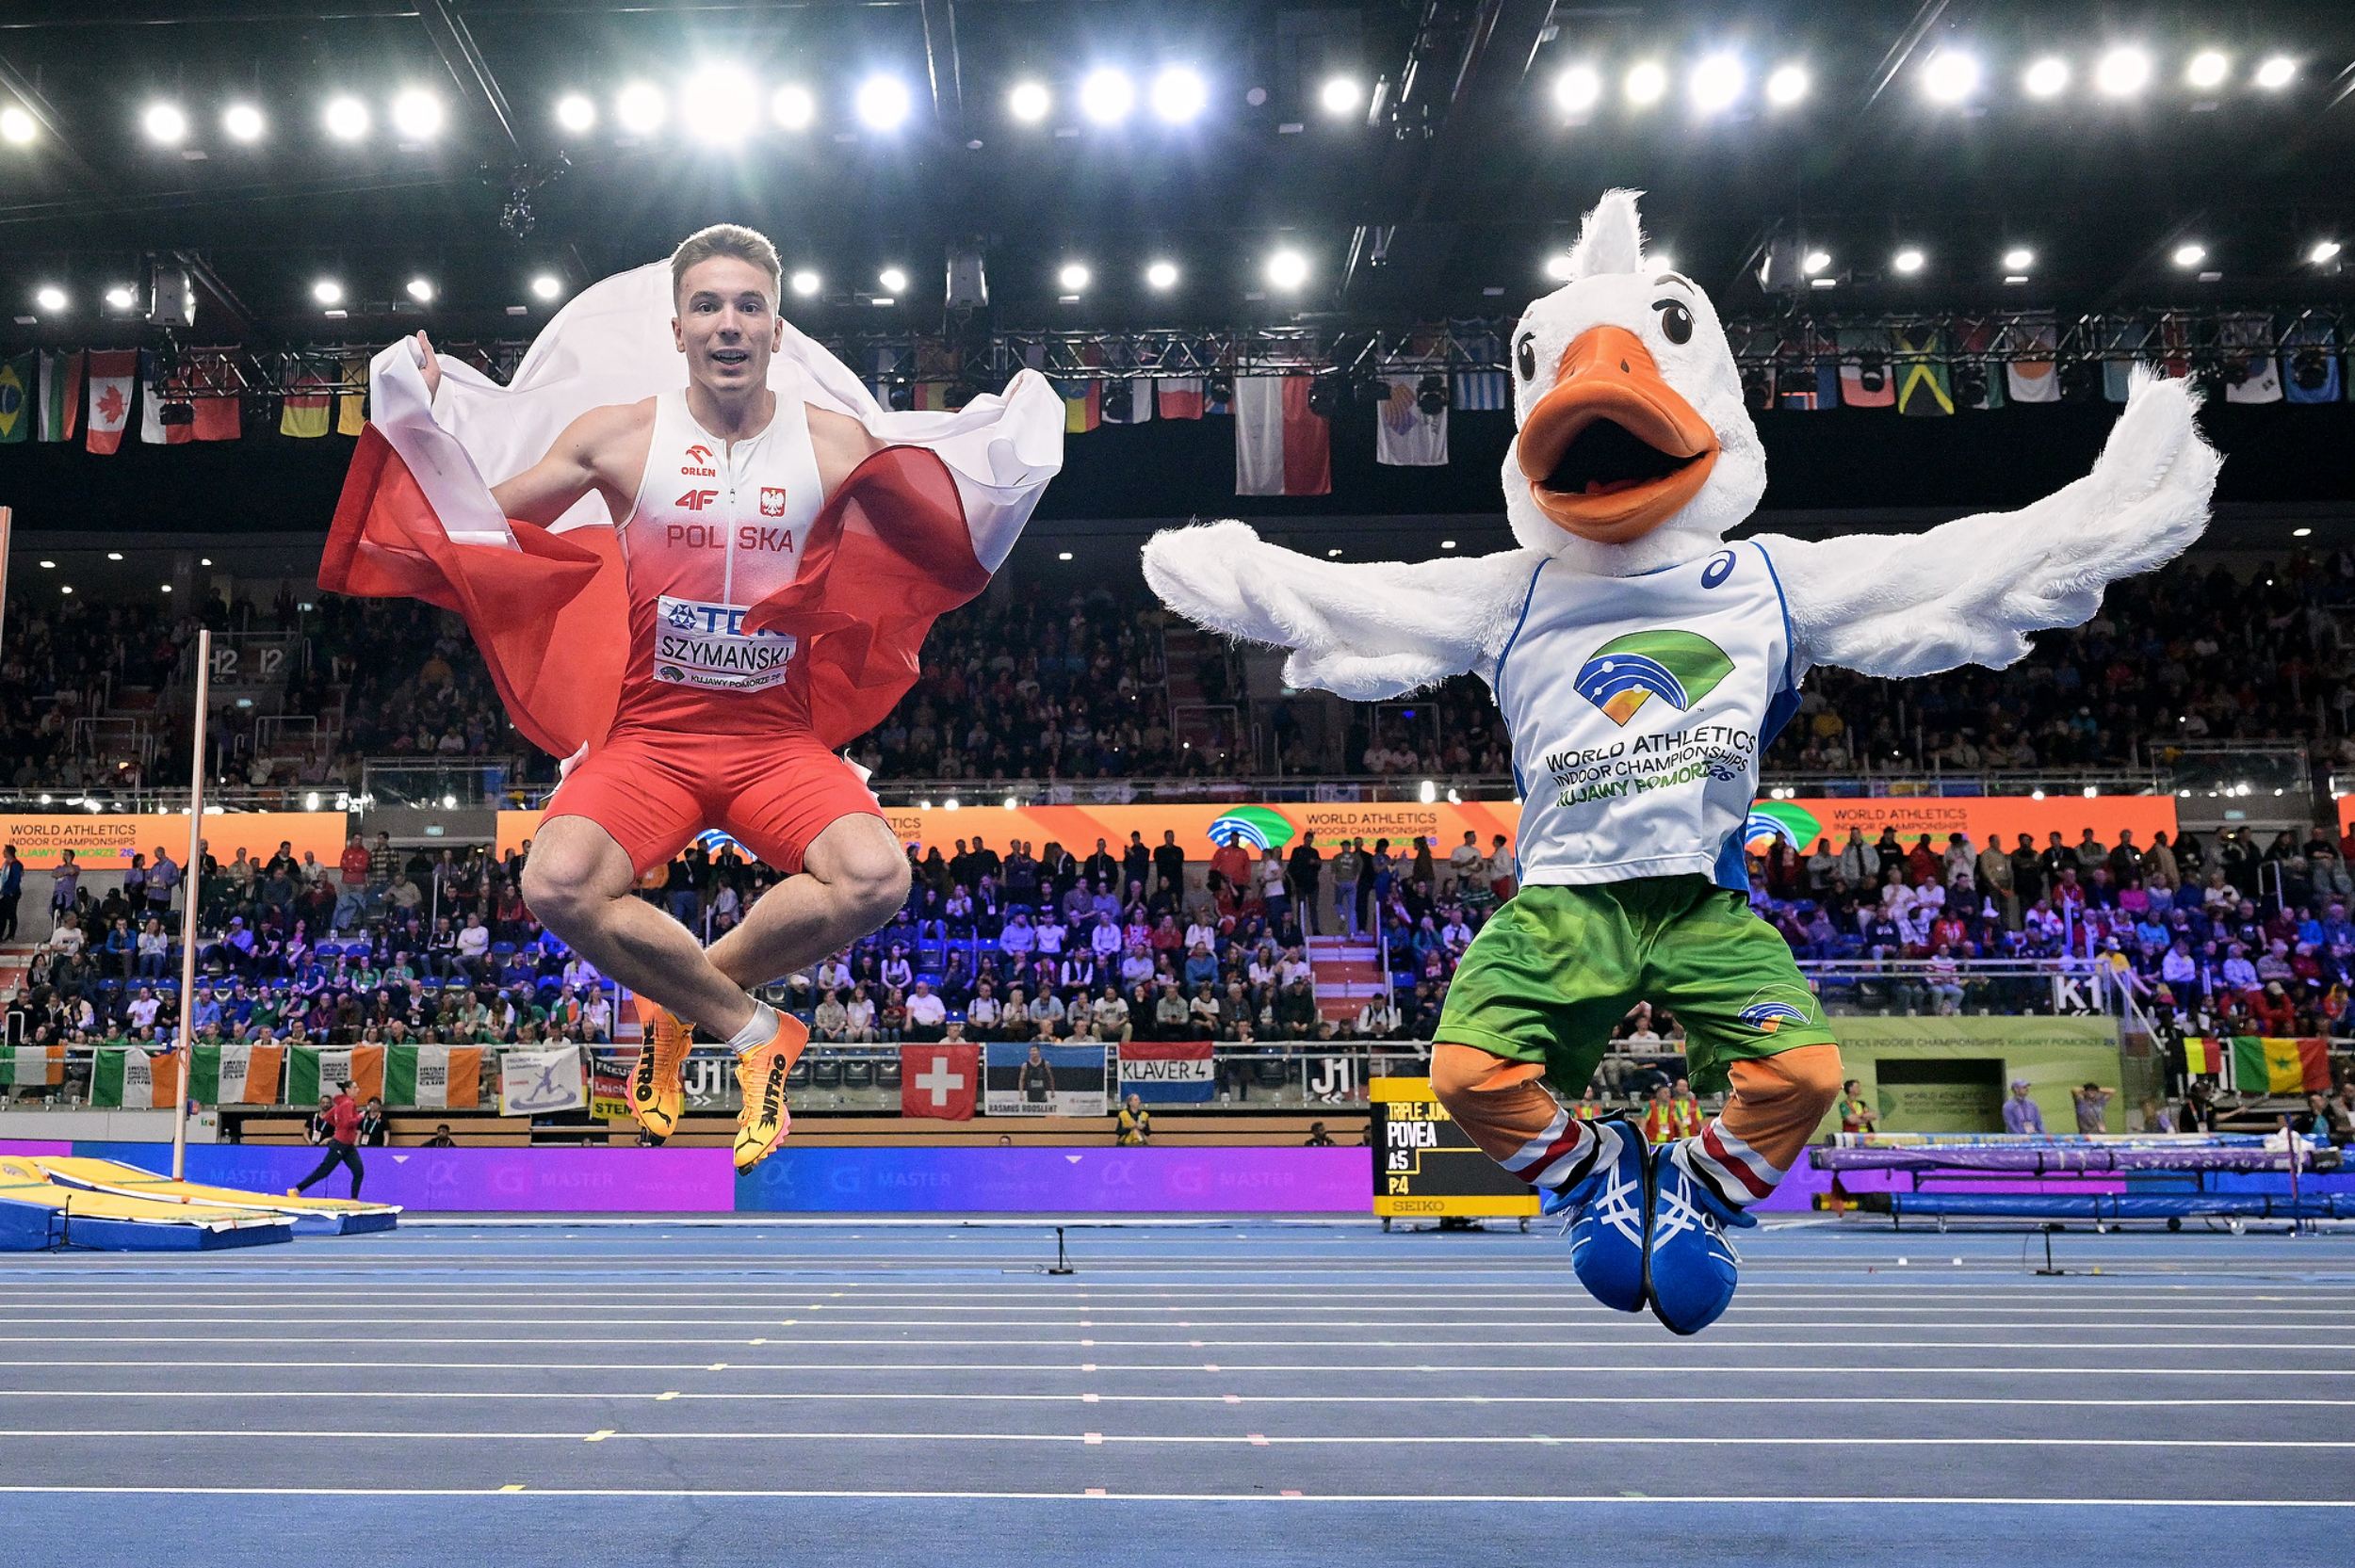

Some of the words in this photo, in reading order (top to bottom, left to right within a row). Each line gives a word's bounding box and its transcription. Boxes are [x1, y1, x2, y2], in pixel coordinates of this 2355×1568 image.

[681, 466, 716, 477] ORLEN
[674, 489, 720, 510] 4F
[666, 525, 794, 554] POLSKA
[697, 606, 787, 637] TD
[661, 635, 790, 671] SZYMAŃSKI
[690, 674, 729, 687] KUJAWY
[1546, 741, 1625, 773] WORLD
[1632, 725, 1757, 755] ATHLETICS
[1552, 764, 1612, 787] INDOOR
[1615, 746, 1748, 776] CHAMPIONSHIPS
[1556, 779, 1630, 807] KUJAWY
[1307, 813, 1357, 825] WORLD
[1361, 813, 1437, 825] ATHLETICS
[1833, 809, 1885, 820] WORLD
[1890, 808, 1967, 820] ATHLETICS
[10, 824, 60, 835] WORLD
[64, 824, 137, 835] ATHLETICS
[1350, 826, 1437, 835] CHAMPIONSHIPS
[9, 837, 49, 847] INDOOR
[52, 837, 136, 847] CHAMPIONSHIPS
[15, 848, 57, 858] UJAWY
[120, 848, 136, 858] 26
[2055, 975, 2102, 1010] K1
[635, 1018, 656, 1102] NITRO
[1122, 1061, 1190, 1080] KLAVER
[1194, 1060, 1206, 1078] 4
[684, 1059, 722, 1095] J1
[1311, 1058, 1350, 1094] J1
[757, 1053, 787, 1131] NITRO
[1387, 1121, 1437, 1148] POVEA
[542, 1172, 613, 1188] MASTER
[878, 1172, 950, 1188] MASTER
[1392, 1200, 1445, 1212] SEIKO
